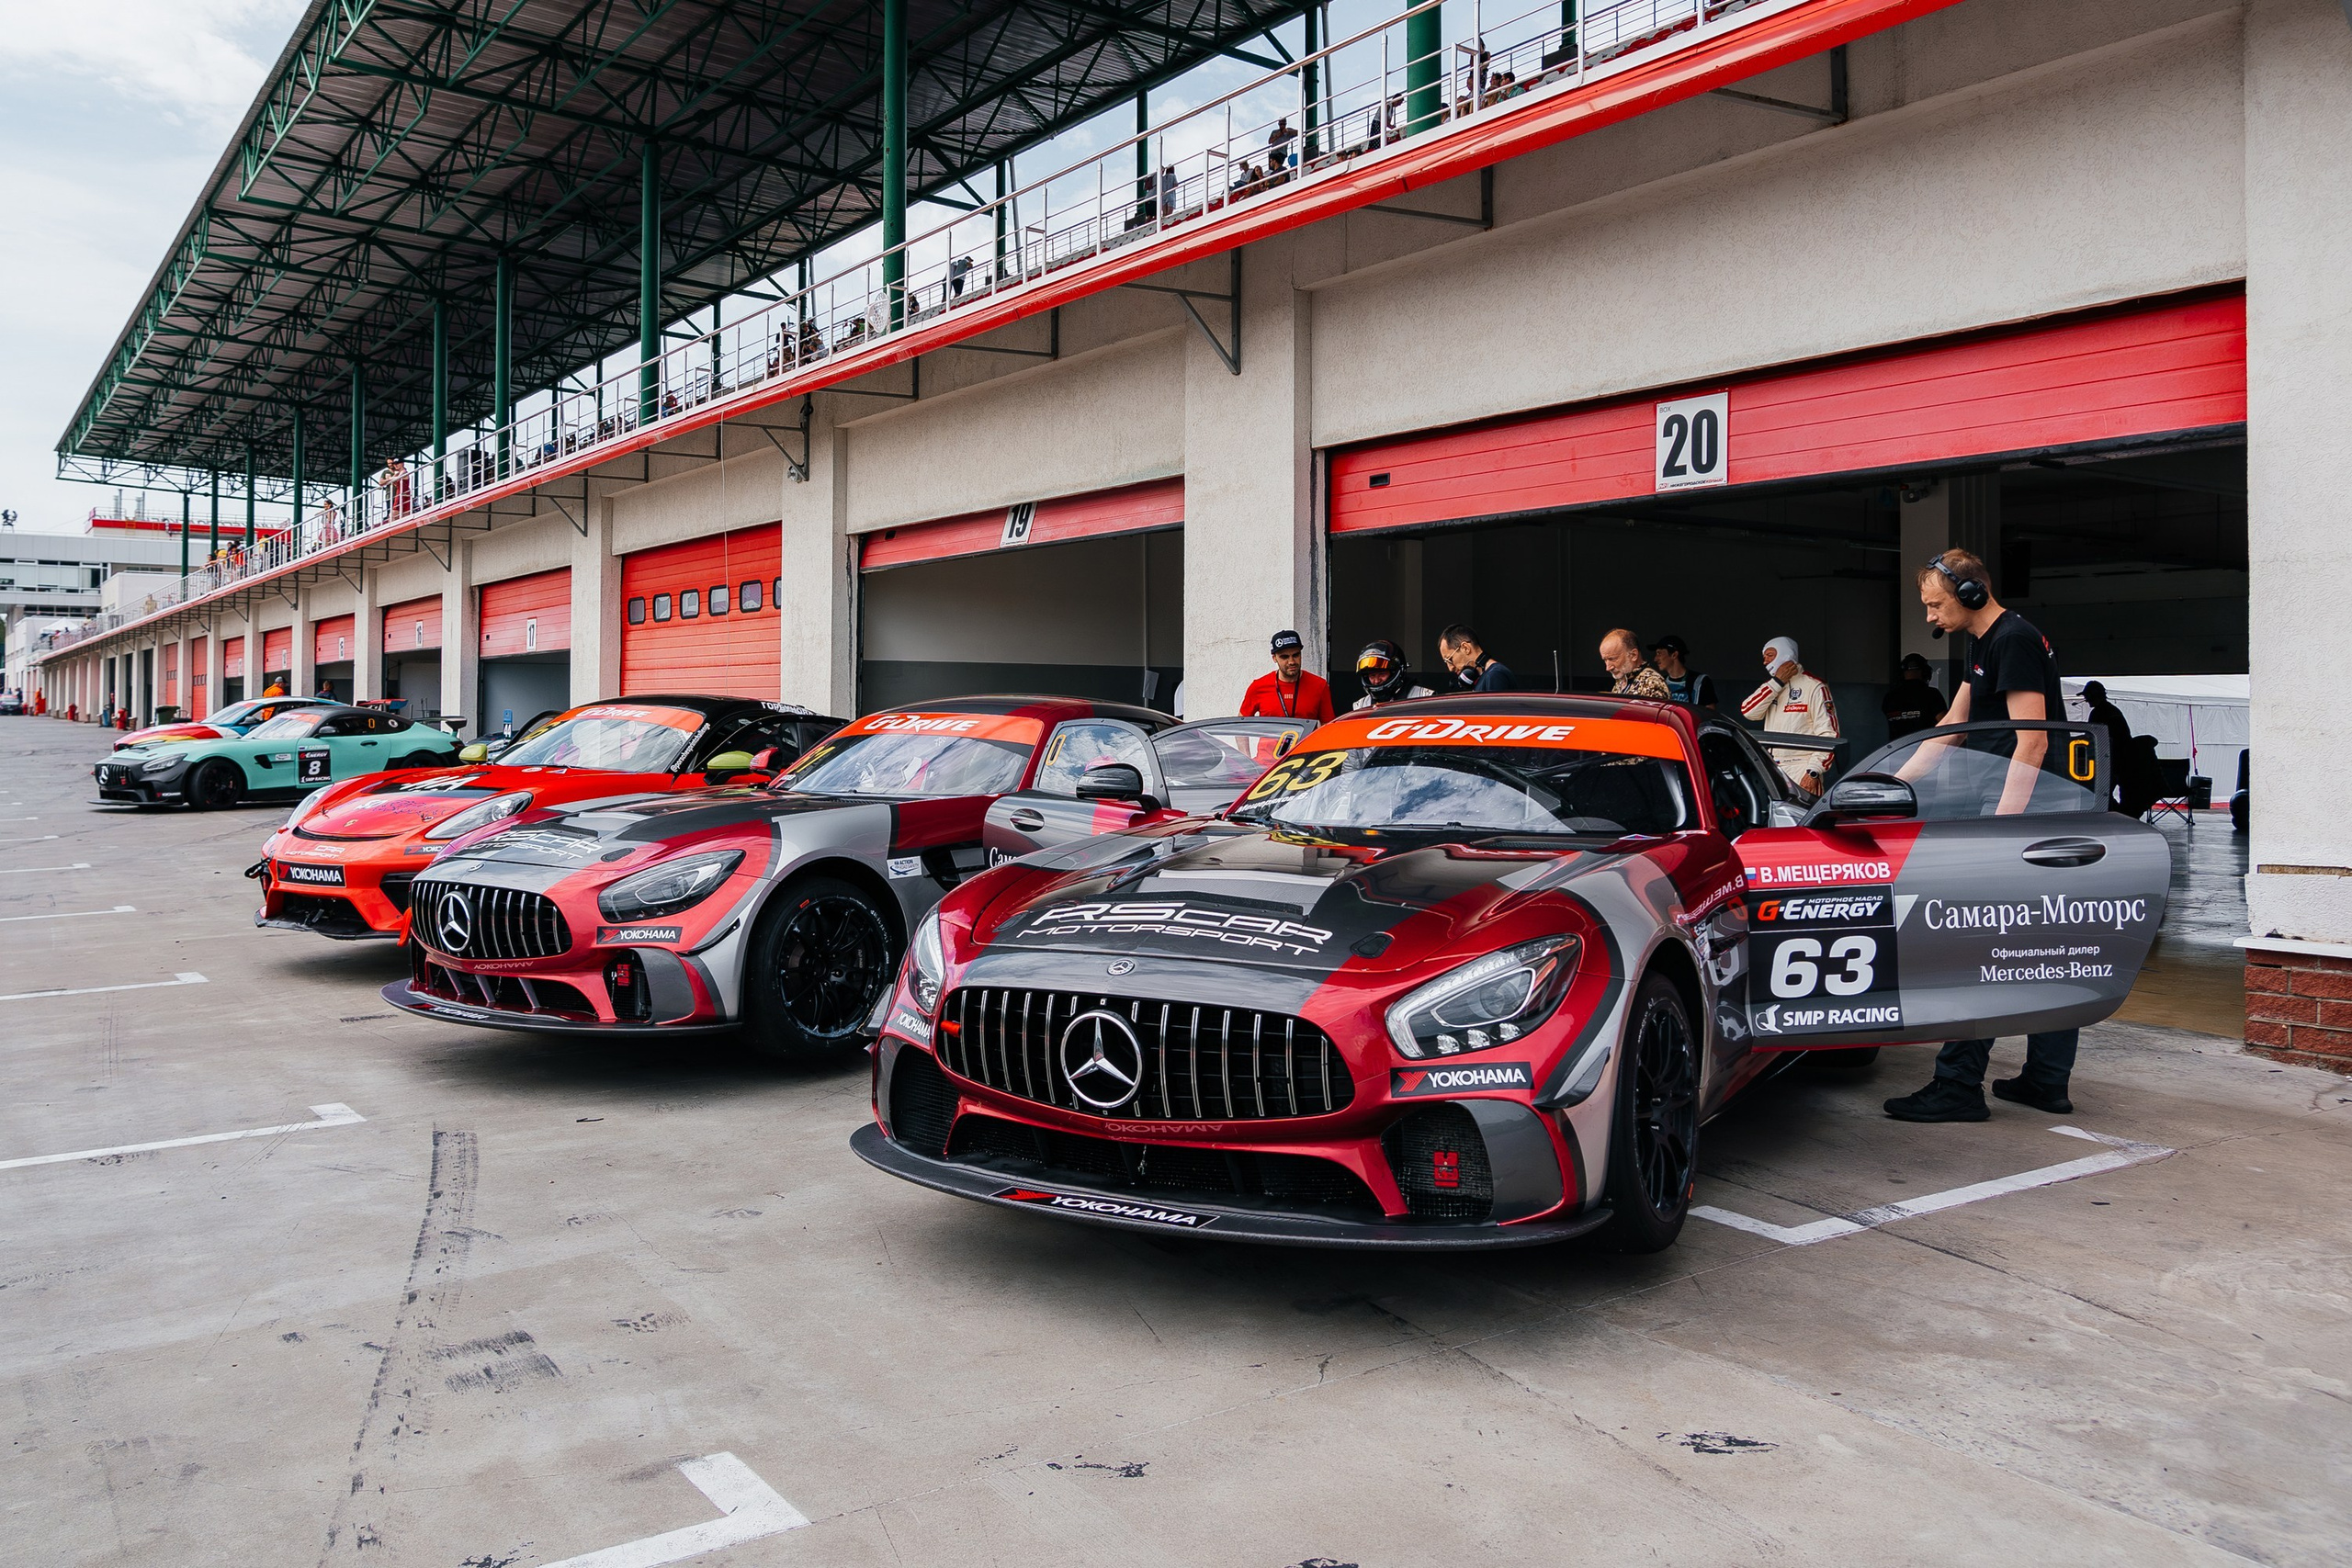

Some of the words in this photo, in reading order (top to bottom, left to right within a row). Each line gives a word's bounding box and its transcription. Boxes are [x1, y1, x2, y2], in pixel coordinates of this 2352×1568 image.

[1662, 409, 1719, 478] 20
[1008, 502, 1033, 538] 19
[529, 625, 535, 647] 17
[309, 761, 322, 775] 8
[1248, 751, 1349, 800] 63
[290, 866, 343, 883] YOKOHAMA
[1759, 862, 1891, 884] В.МЕЩЕРЯКОВ
[1031, 902, 1333, 945] RSCAR
[1924, 894, 2146, 935] Самара-Моторс
[619, 929, 676, 941] YOKOHAMA
[1016, 924, 1319, 956] MOTORSPORT
[1991, 945, 2065, 960] Официальный
[2067, 946, 2100, 956] дилер
[1770, 935, 1877, 998] 63
[1980, 961, 2113, 983] Mercedes-Benz
[897, 1011, 931, 1039] YOKOHAMA
[1782, 1010, 1825, 1027] SMP
[1827, 1006, 1899, 1025] RACING
[1428, 1067, 1527, 1089] YOKOHAMA
[1051, 1196, 1197, 1225] YOKOHAMA
